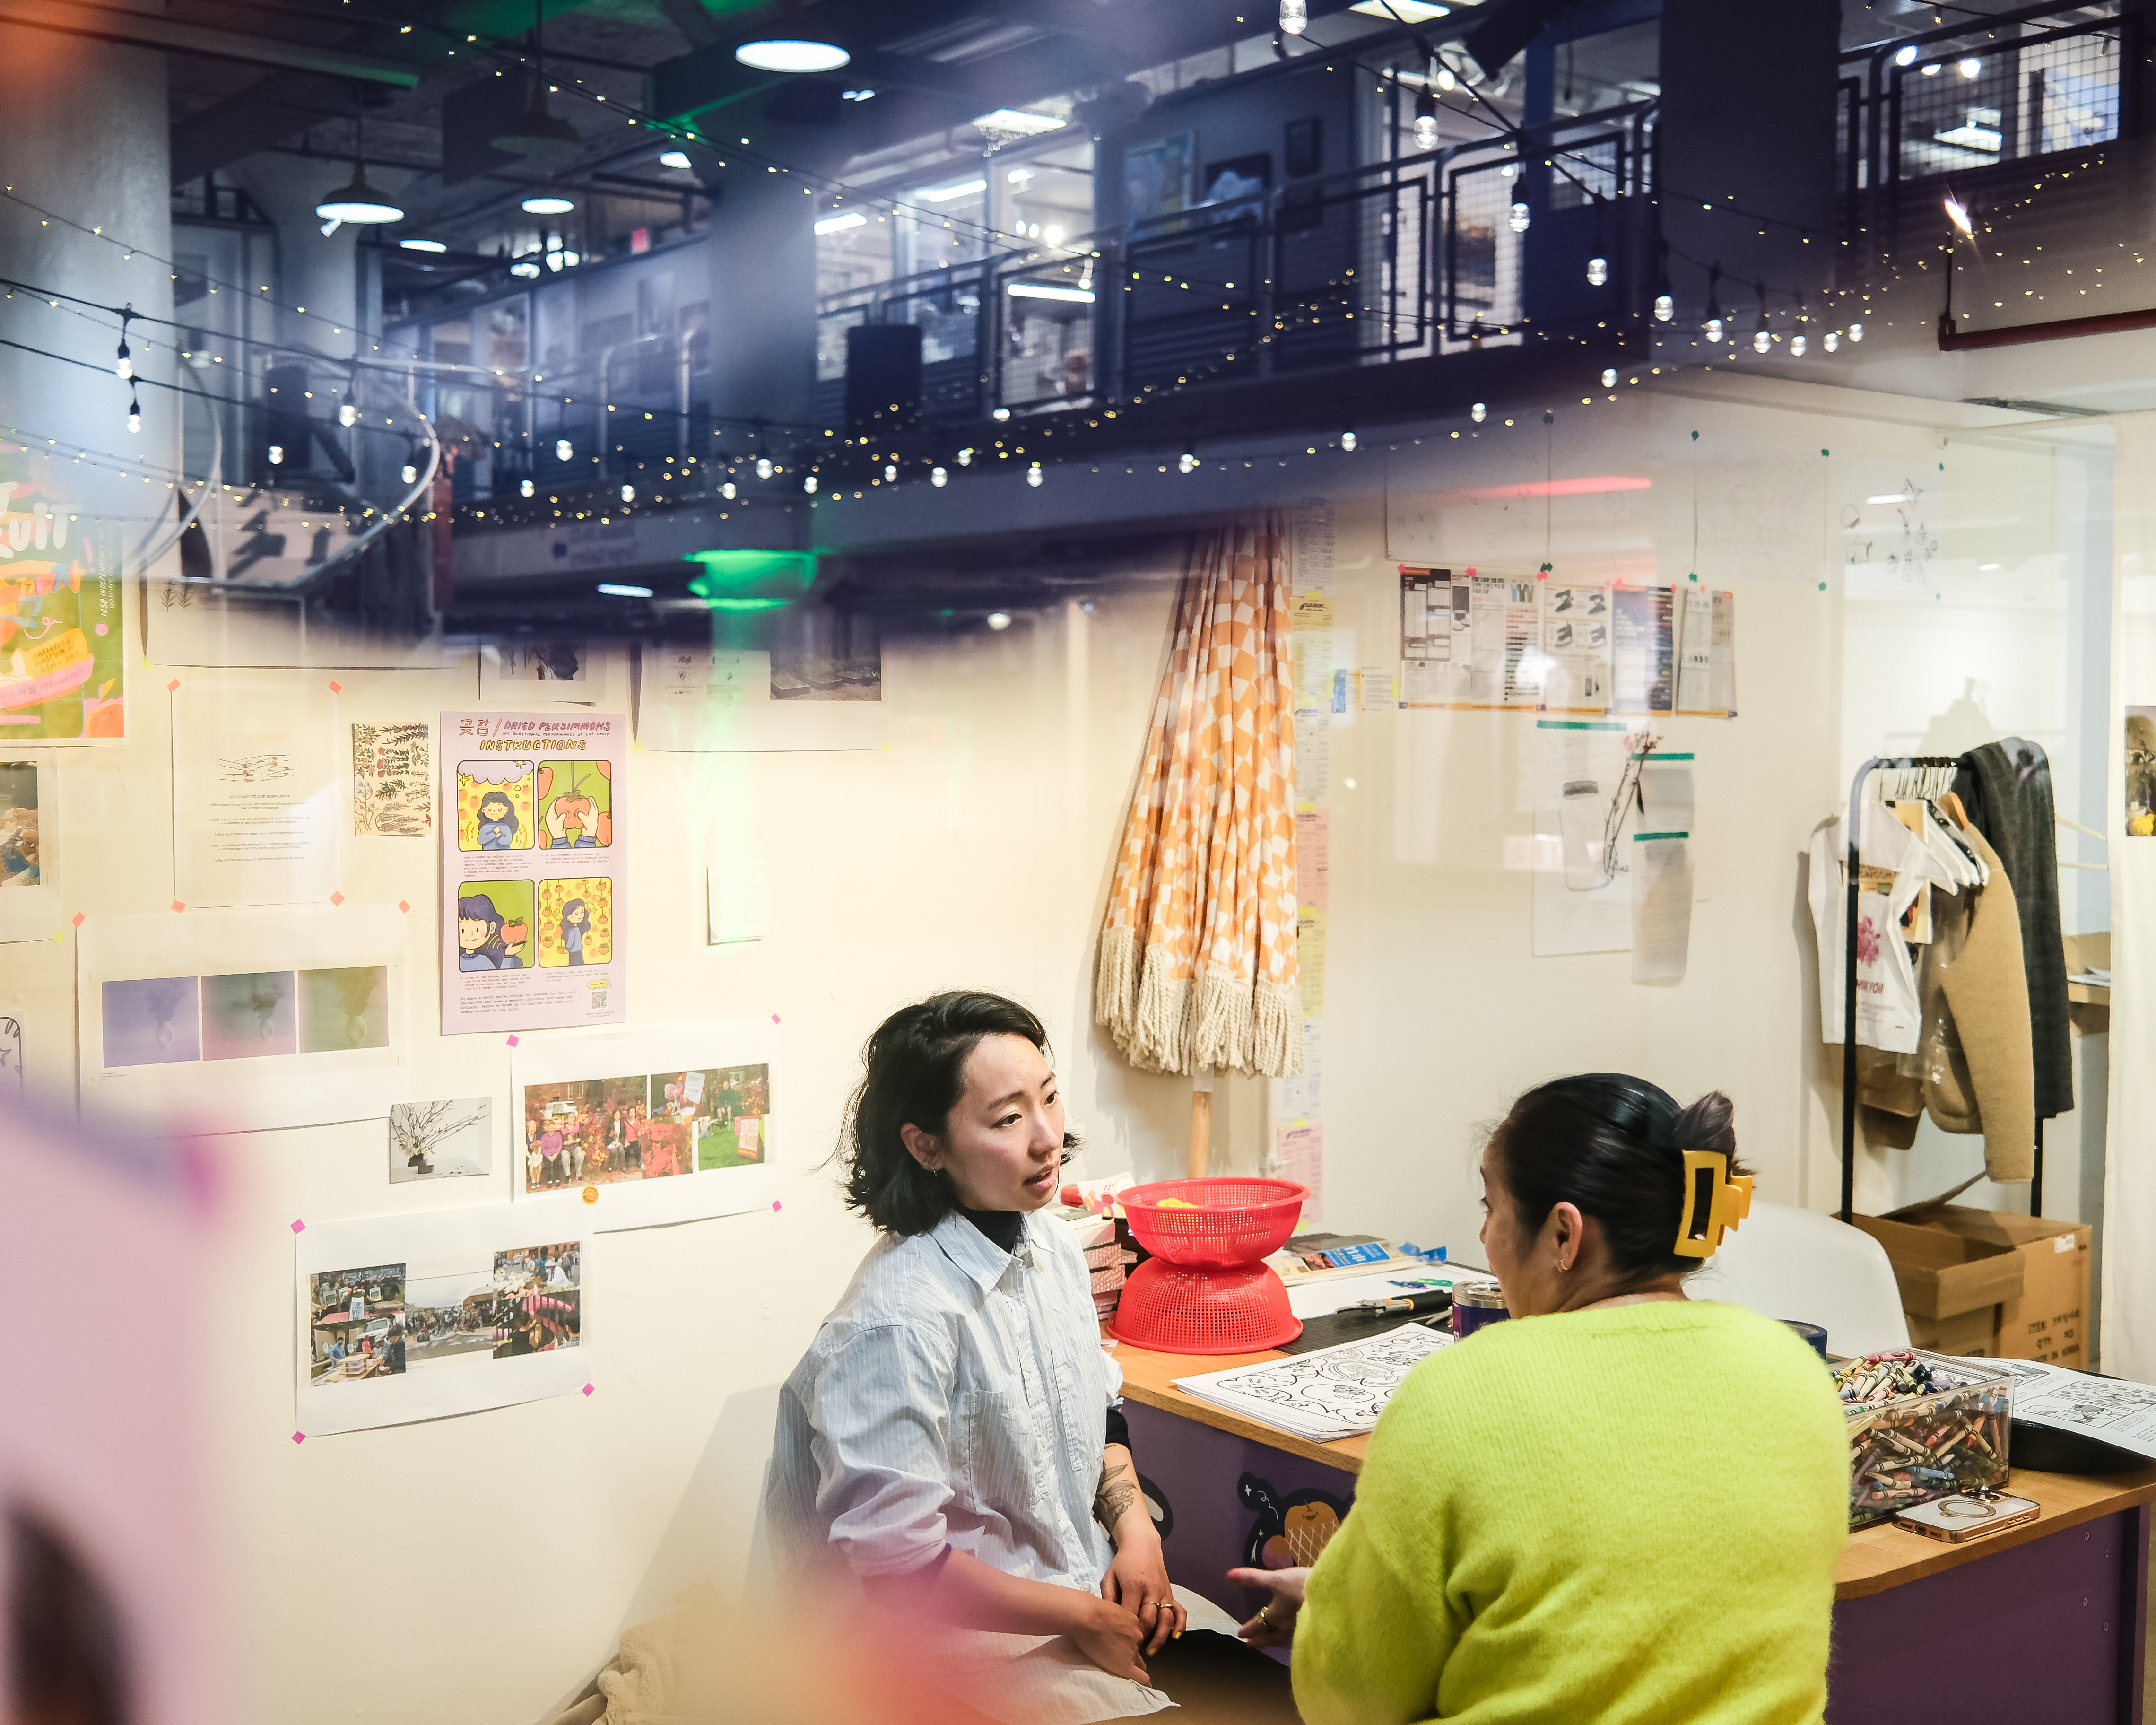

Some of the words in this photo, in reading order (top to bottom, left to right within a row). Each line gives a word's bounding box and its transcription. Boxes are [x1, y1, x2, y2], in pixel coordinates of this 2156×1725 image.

[33, 638, 70, 660] NATIONAL
[35, 649, 65, 667] MUSEUM
[40, 660, 62, 673] ASIAN
[66, 651, 79, 662] ART
[459, 719, 490, 736] 곶감
[504, 721, 535, 731] DRIED
[539, 721, 611, 732] PERSIMMONS
[480, 739, 586, 751] INSTRUCTIONS
